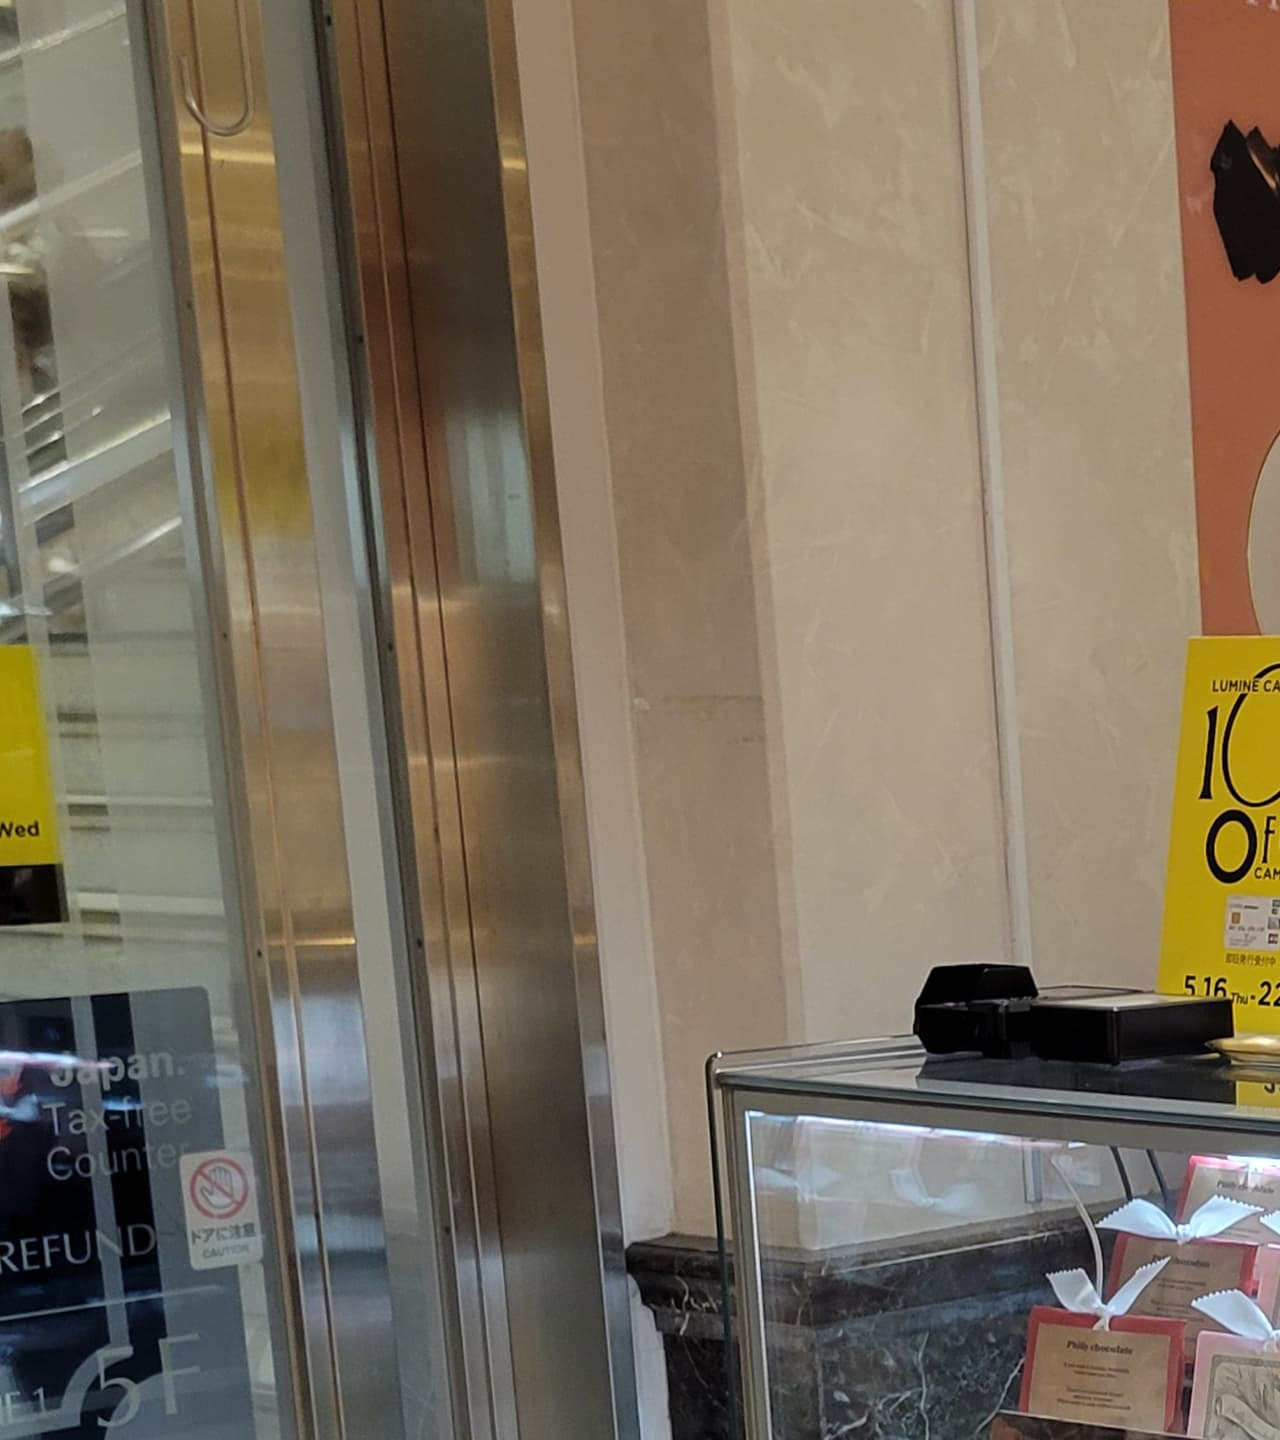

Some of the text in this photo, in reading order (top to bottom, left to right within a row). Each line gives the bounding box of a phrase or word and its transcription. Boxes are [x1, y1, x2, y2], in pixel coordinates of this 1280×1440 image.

[1212, 679, 1260, 693] LUMINE
[1231, 992, 1249, 1005] Thu
[50, 1050, 185, 1090] Japan.
[42, 1095, 192, 1136] Tax-free
[1066, 1339, 1134, 1355] Philly chocolate
